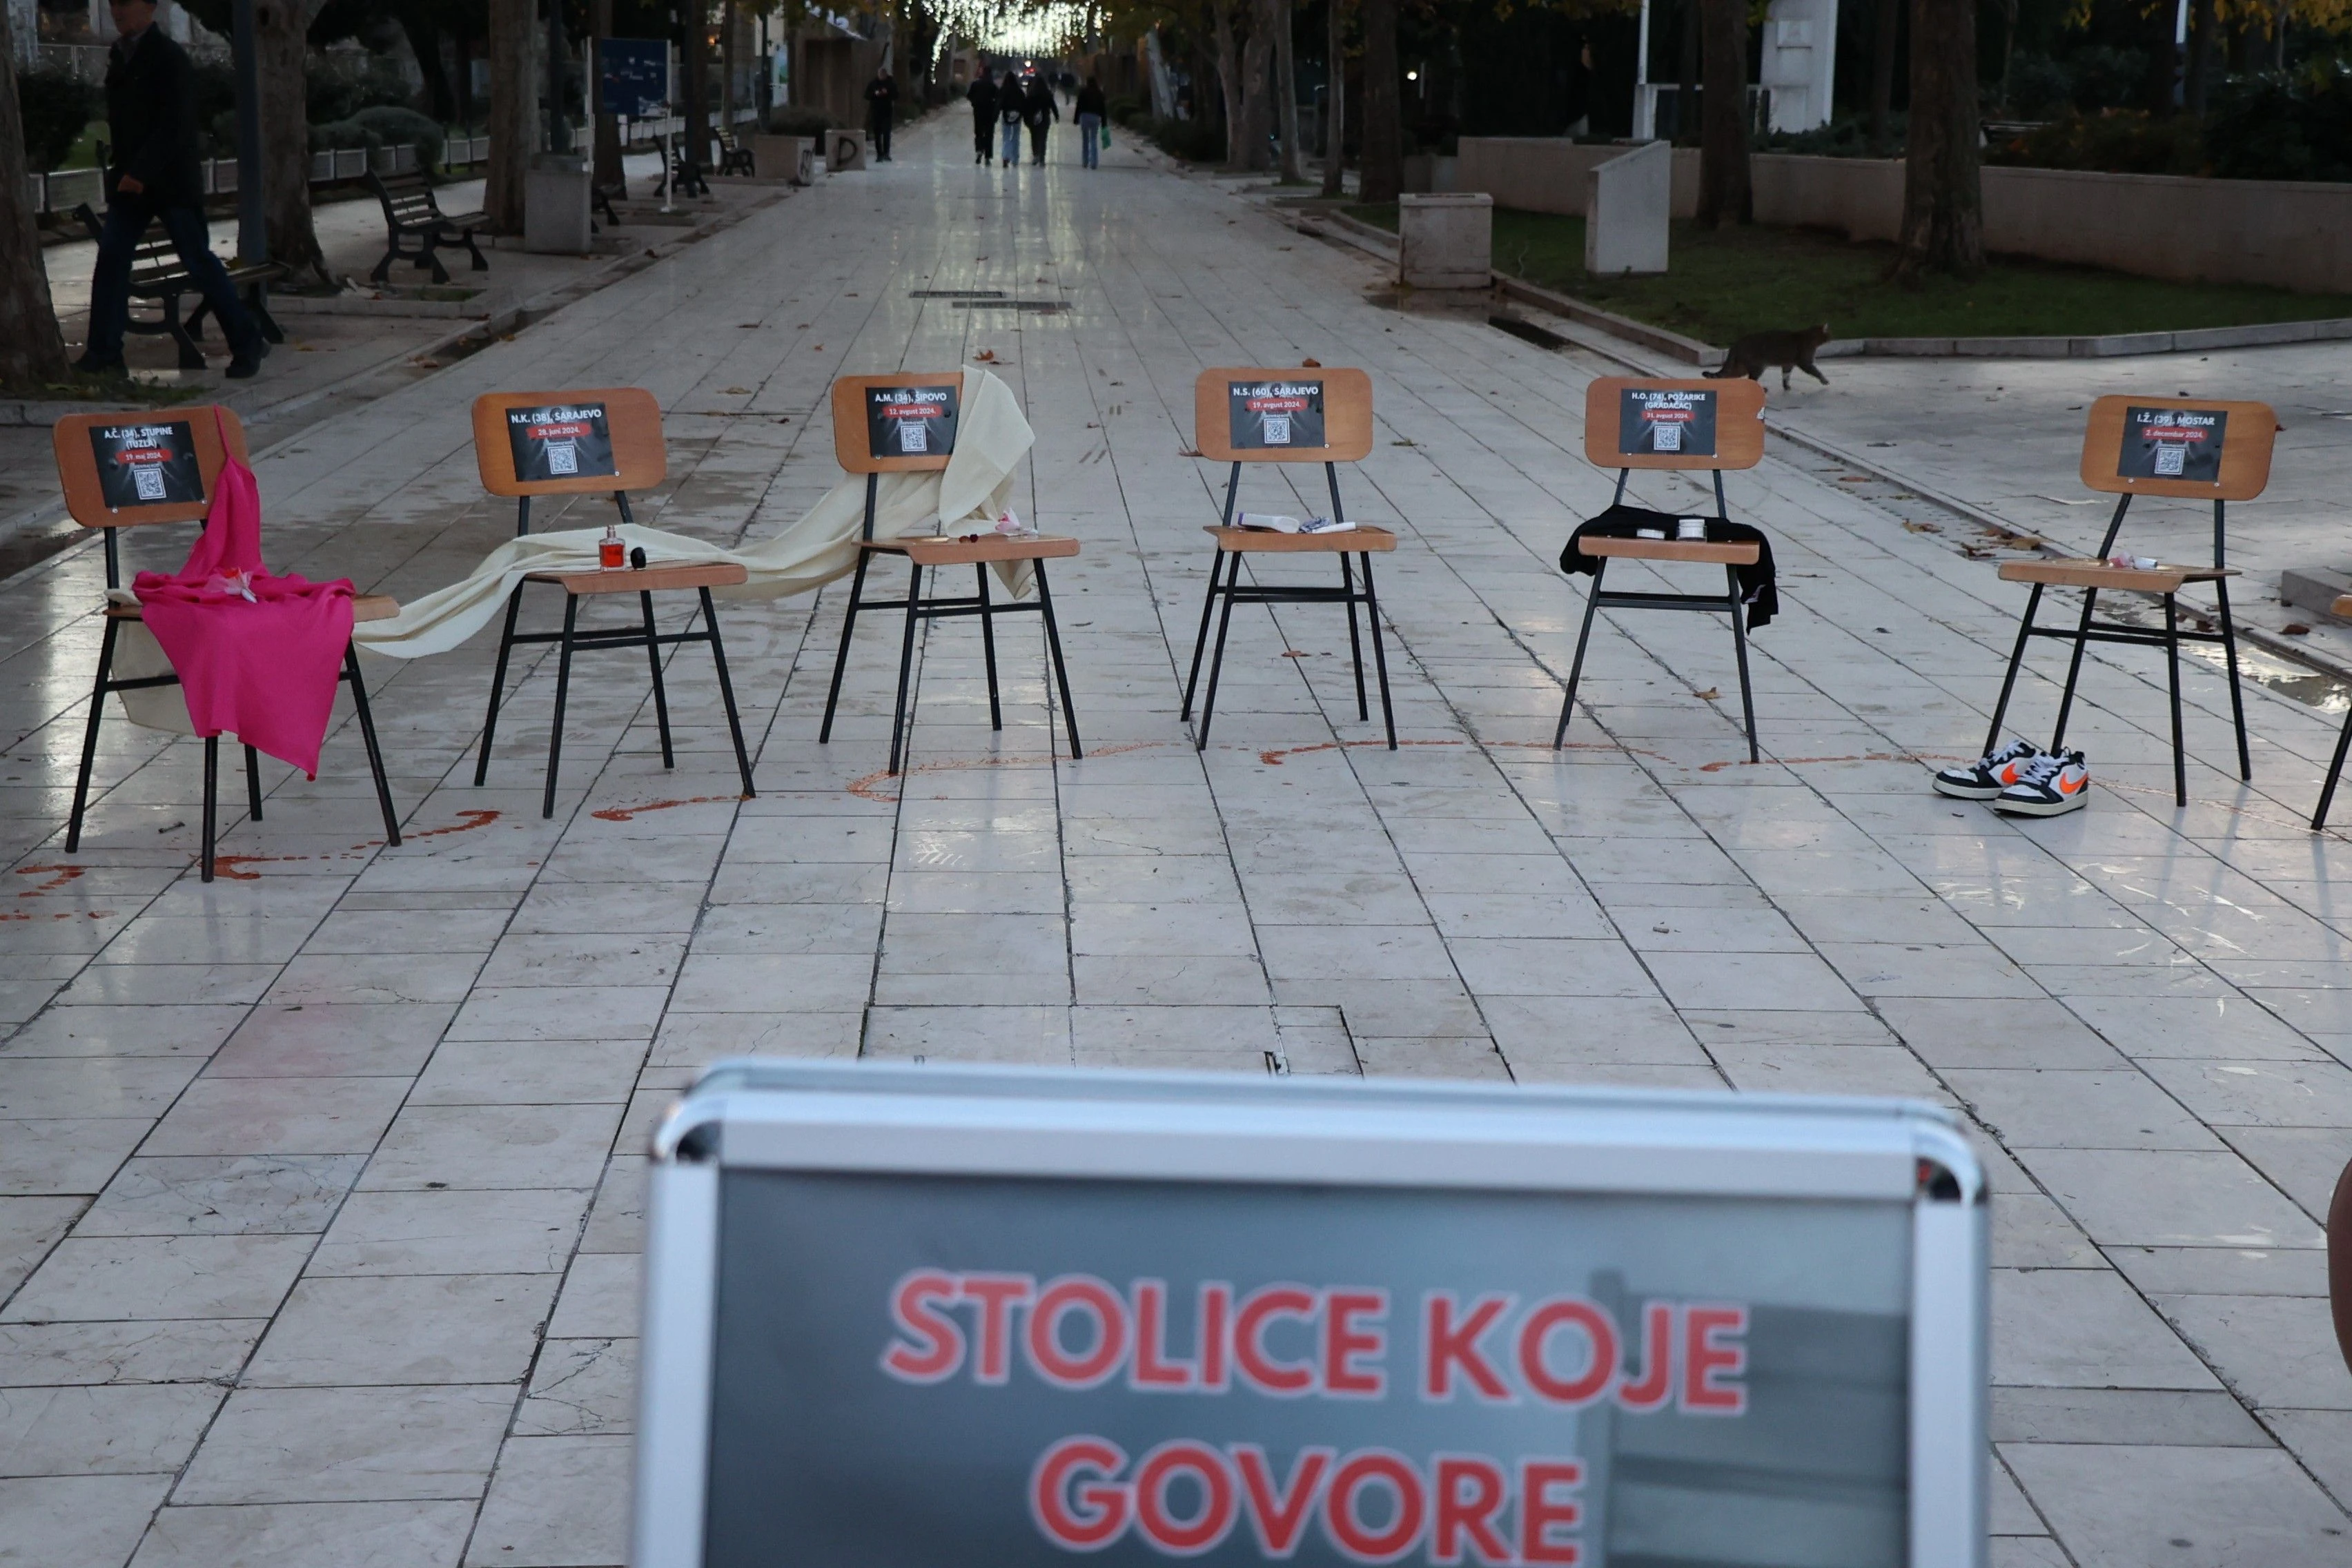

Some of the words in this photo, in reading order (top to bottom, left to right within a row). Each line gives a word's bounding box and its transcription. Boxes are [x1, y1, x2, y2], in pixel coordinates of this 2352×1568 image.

[875, 393, 893, 402] A.M.
[895, 393, 914, 403] (34),
[915, 391, 947, 401] ŠIPOVO
[1252, 388, 1272, 398] (60),
[1274, 386, 1318, 395] SARAJEVO
[1649, 393, 1667, 402] (74),
[1667, 391, 1705, 400] POŽARIKE
[1645, 401, 1692, 410] (GRADAČAC)
[511, 414, 530, 423] N.K.
[532, 413, 553, 424] (38),
[555, 409, 602, 421] SARAJEVO
[2154, 415, 2175, 426] (39),
[2177, 416, 2215, 426] MOSTAR
[139, 427, 173, 437] STUPINE
[562, 426, 580, 434] 2024.
[126, 439, 157, 450] (TUZLA)
[882, 1266, 1386, 1398] STOLICE
[1420, 1291, 1747, 1417] KOJE
[1030, 1434, 1587, 1566] GOVORE
